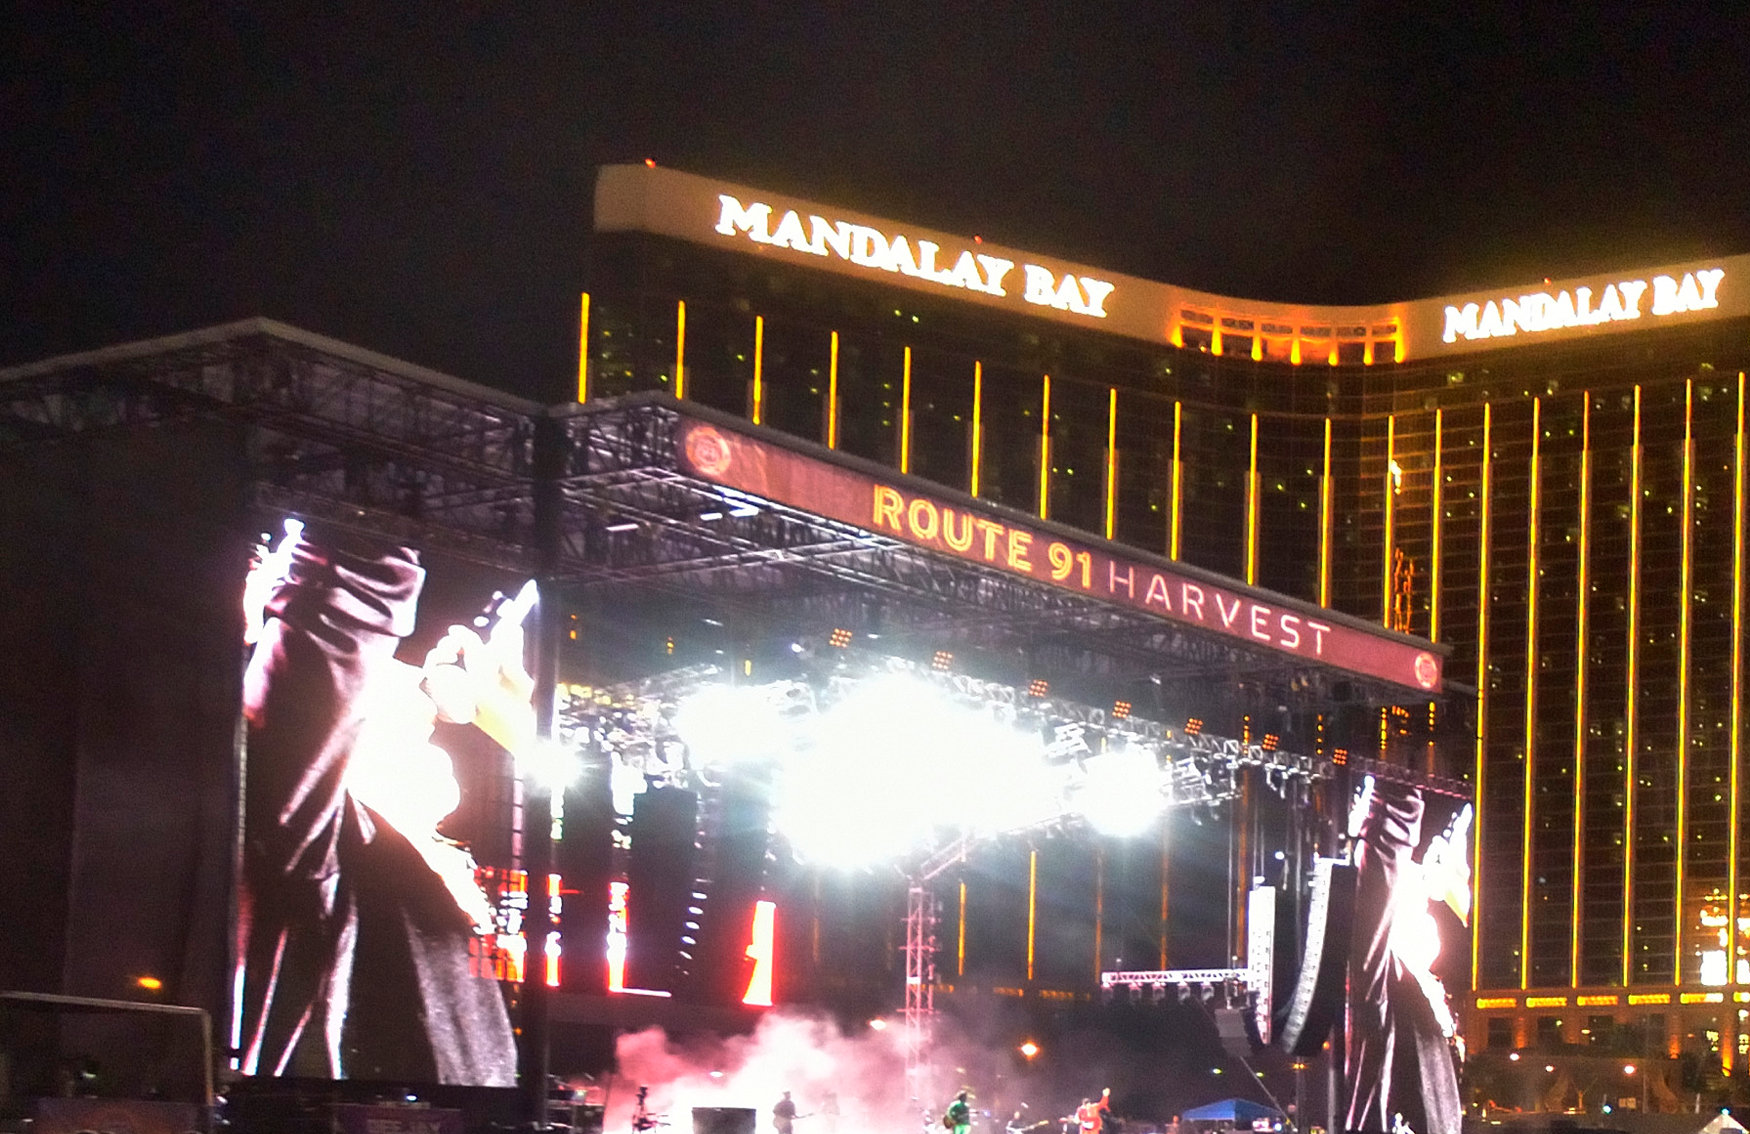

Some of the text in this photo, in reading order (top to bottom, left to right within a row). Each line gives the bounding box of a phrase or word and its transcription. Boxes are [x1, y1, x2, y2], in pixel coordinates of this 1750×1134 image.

[715, 194, 1115, 318] MANDALAY BAY
[1442, 268, 1725, 344] MANDALAY BAY
[873, 483, 1332, 656] ROUTE 91 HARVEST
